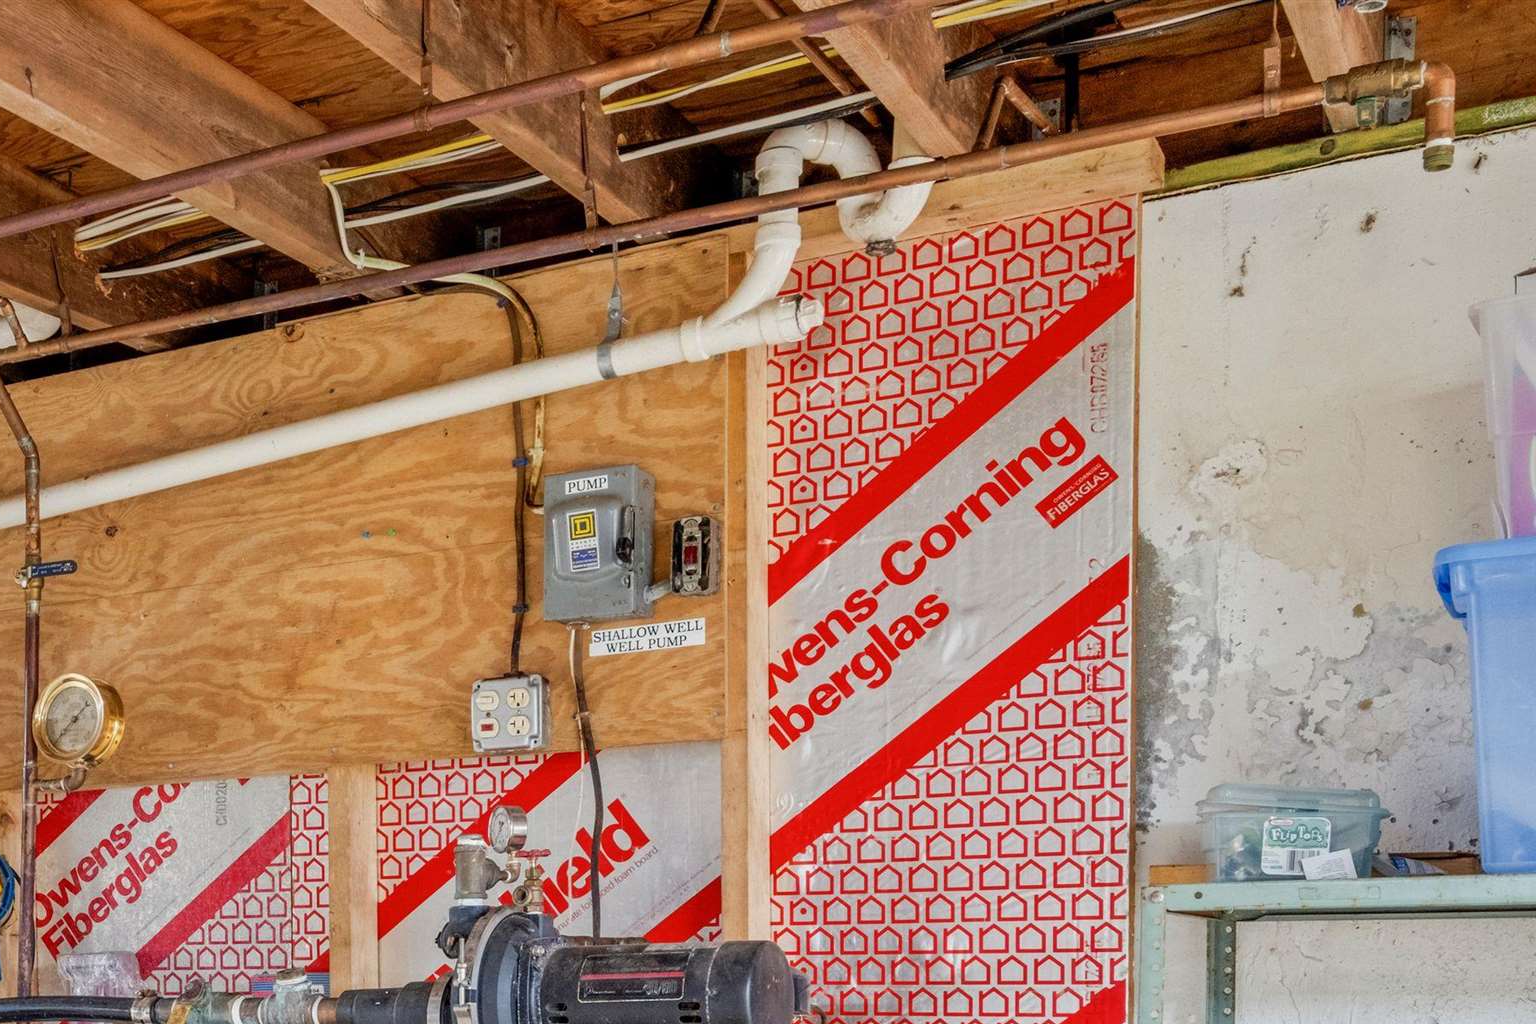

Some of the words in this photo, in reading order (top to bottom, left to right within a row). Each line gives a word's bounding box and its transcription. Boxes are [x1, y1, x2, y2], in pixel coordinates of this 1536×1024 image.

[568, 477, 607, 493] PUMP
[1046, 468, 1110, 521] FIBERGLAS
[768, 416, 1086, 699] wens-Corning
[593, 624, 661, 644] SHALLOW
[664, 620, 704, 634] WELL
[607, 639, 644, 653] WELL
[648, 635, 687, 650] PUMP
[768, 593, 950, 751] iberglas
[41, 831, 178, 961] Fiberglas
